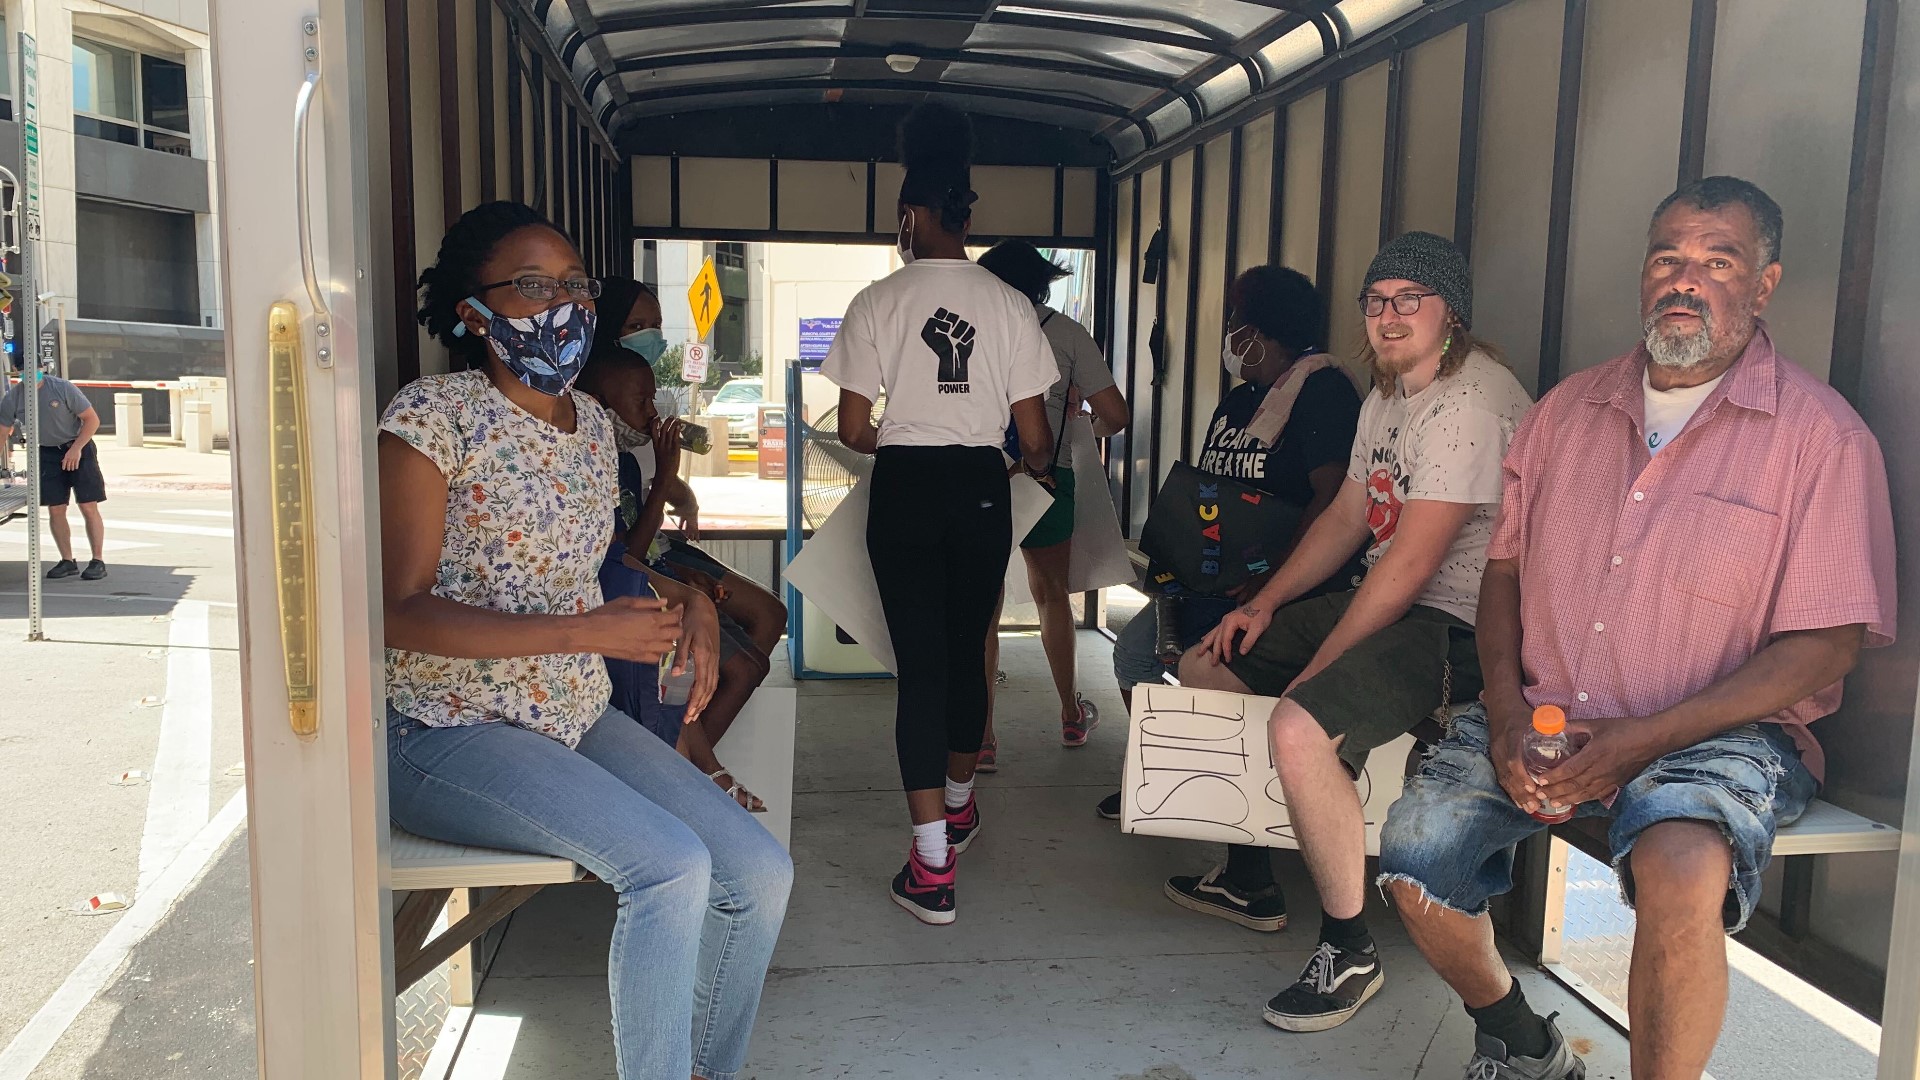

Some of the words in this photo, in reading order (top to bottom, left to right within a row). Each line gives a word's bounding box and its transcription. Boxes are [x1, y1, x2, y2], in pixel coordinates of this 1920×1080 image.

[938, 383, 970, 394] POWER
[1200, 449, 1268, 479] BREATHE
[1199, 482, 1221, 577] BLACK
